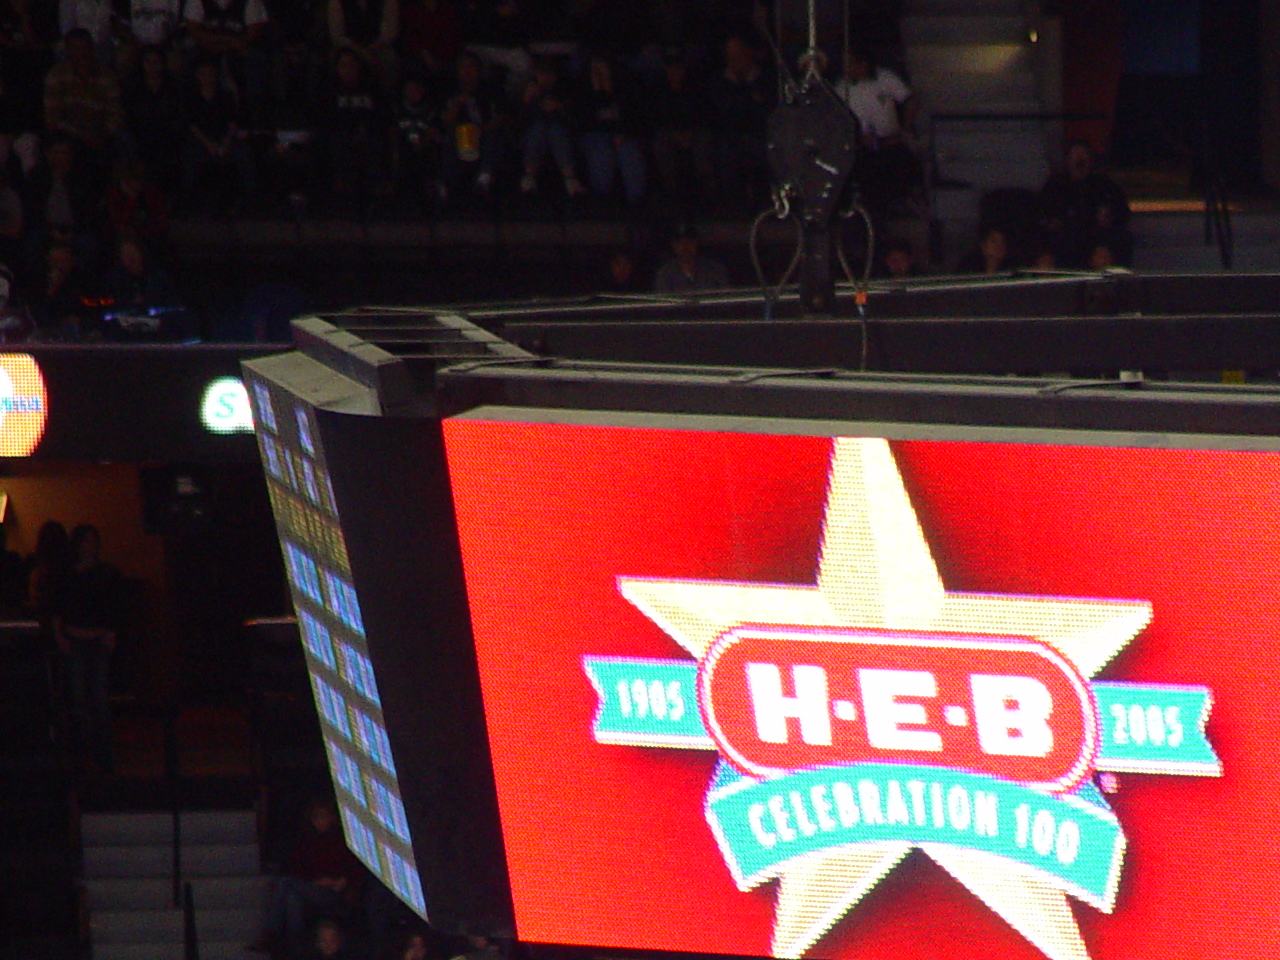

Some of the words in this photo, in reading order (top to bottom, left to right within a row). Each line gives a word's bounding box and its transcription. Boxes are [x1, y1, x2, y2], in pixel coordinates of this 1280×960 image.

[1109, 703, 1183, 747] 2005
[748, 779, 1000, 849] CELEBRATION
[1014, 803, 1079, 866] 100
